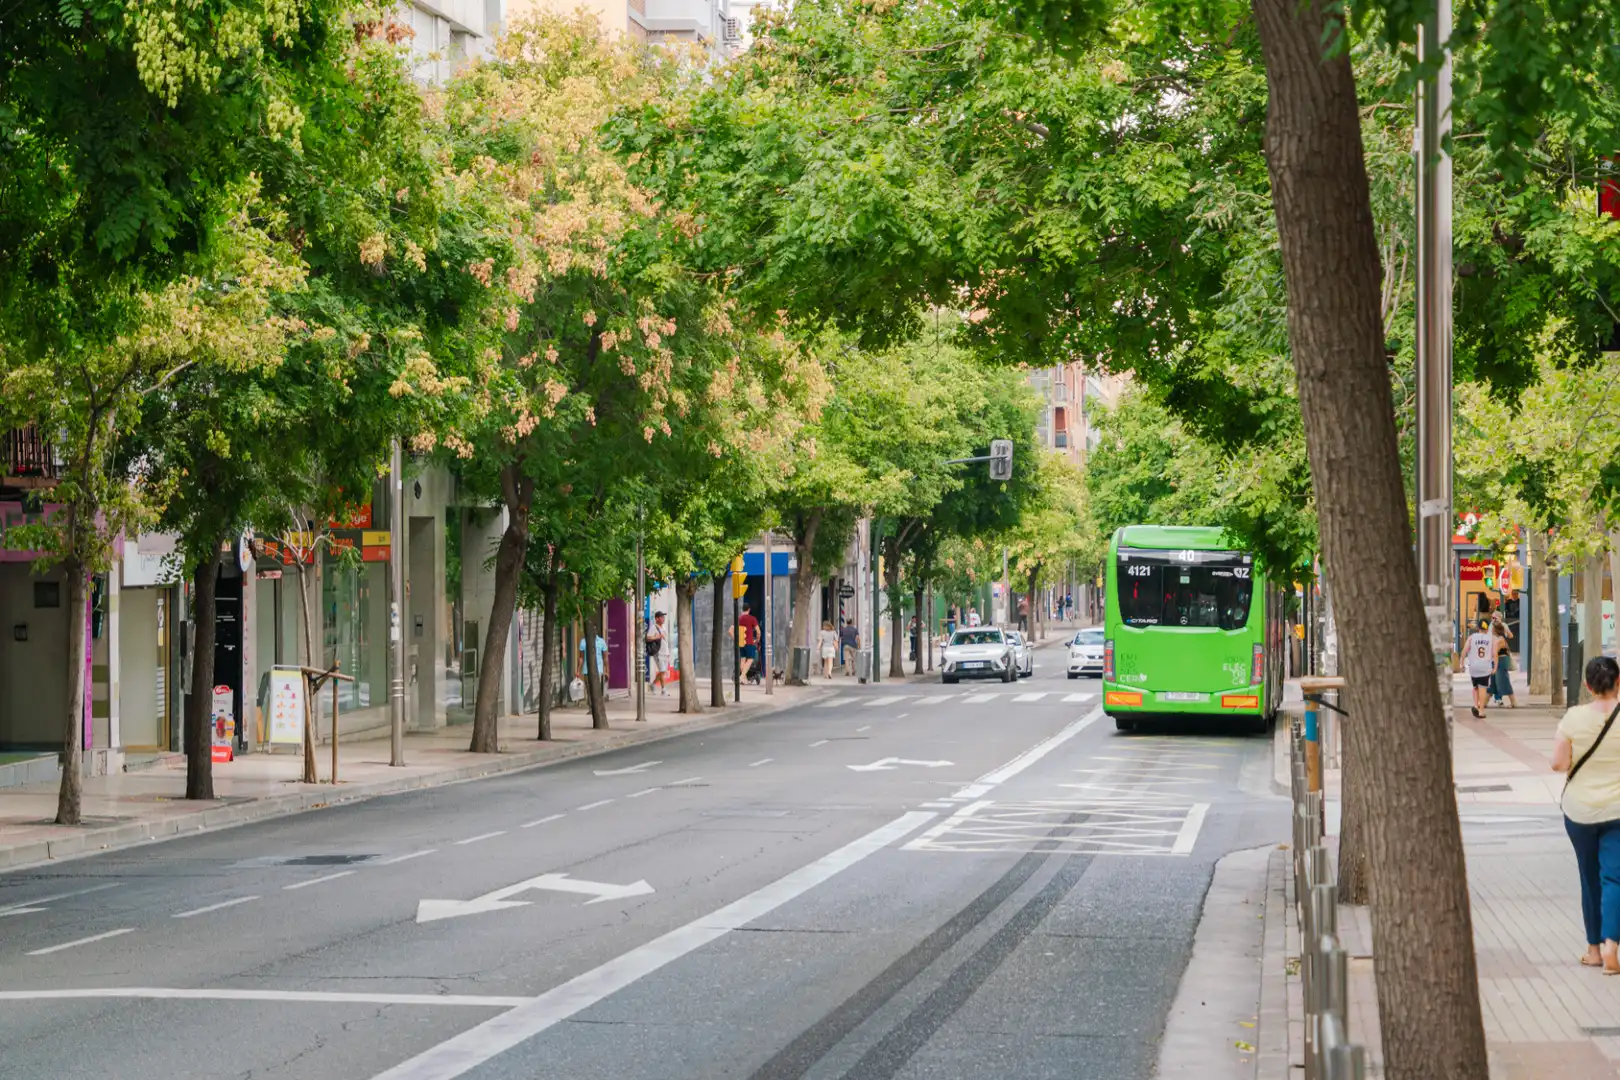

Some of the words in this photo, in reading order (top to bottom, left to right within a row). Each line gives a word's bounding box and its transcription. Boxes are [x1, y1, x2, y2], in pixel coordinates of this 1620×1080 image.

[1178, 550, 1194, 561] 40
[1128, 565, 1151, 576] 4121
[1478, 647, 1485, 658] 6
